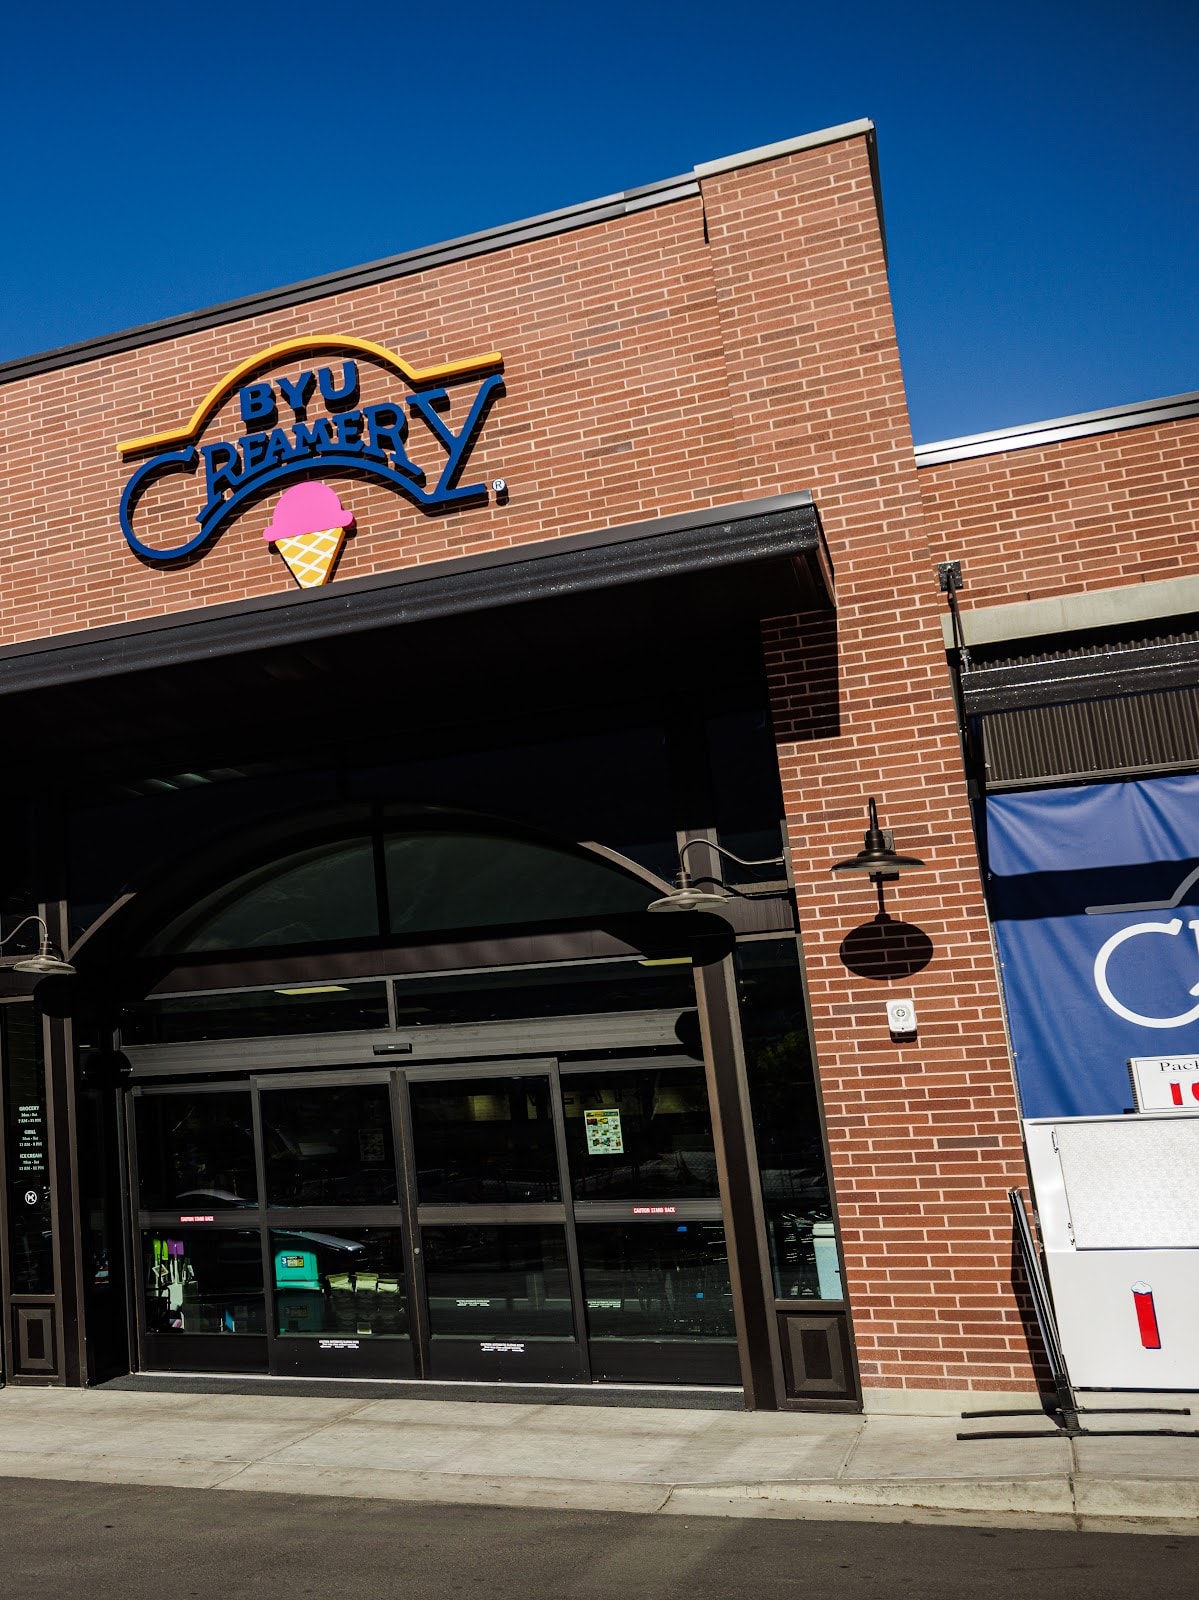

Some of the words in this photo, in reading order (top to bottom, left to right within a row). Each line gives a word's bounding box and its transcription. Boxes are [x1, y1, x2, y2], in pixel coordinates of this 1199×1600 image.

[239, 360, 358, 423] BYU
[119, 374, 503, 559] CREAMERY
[280, 1257, 287, 1265] 3
